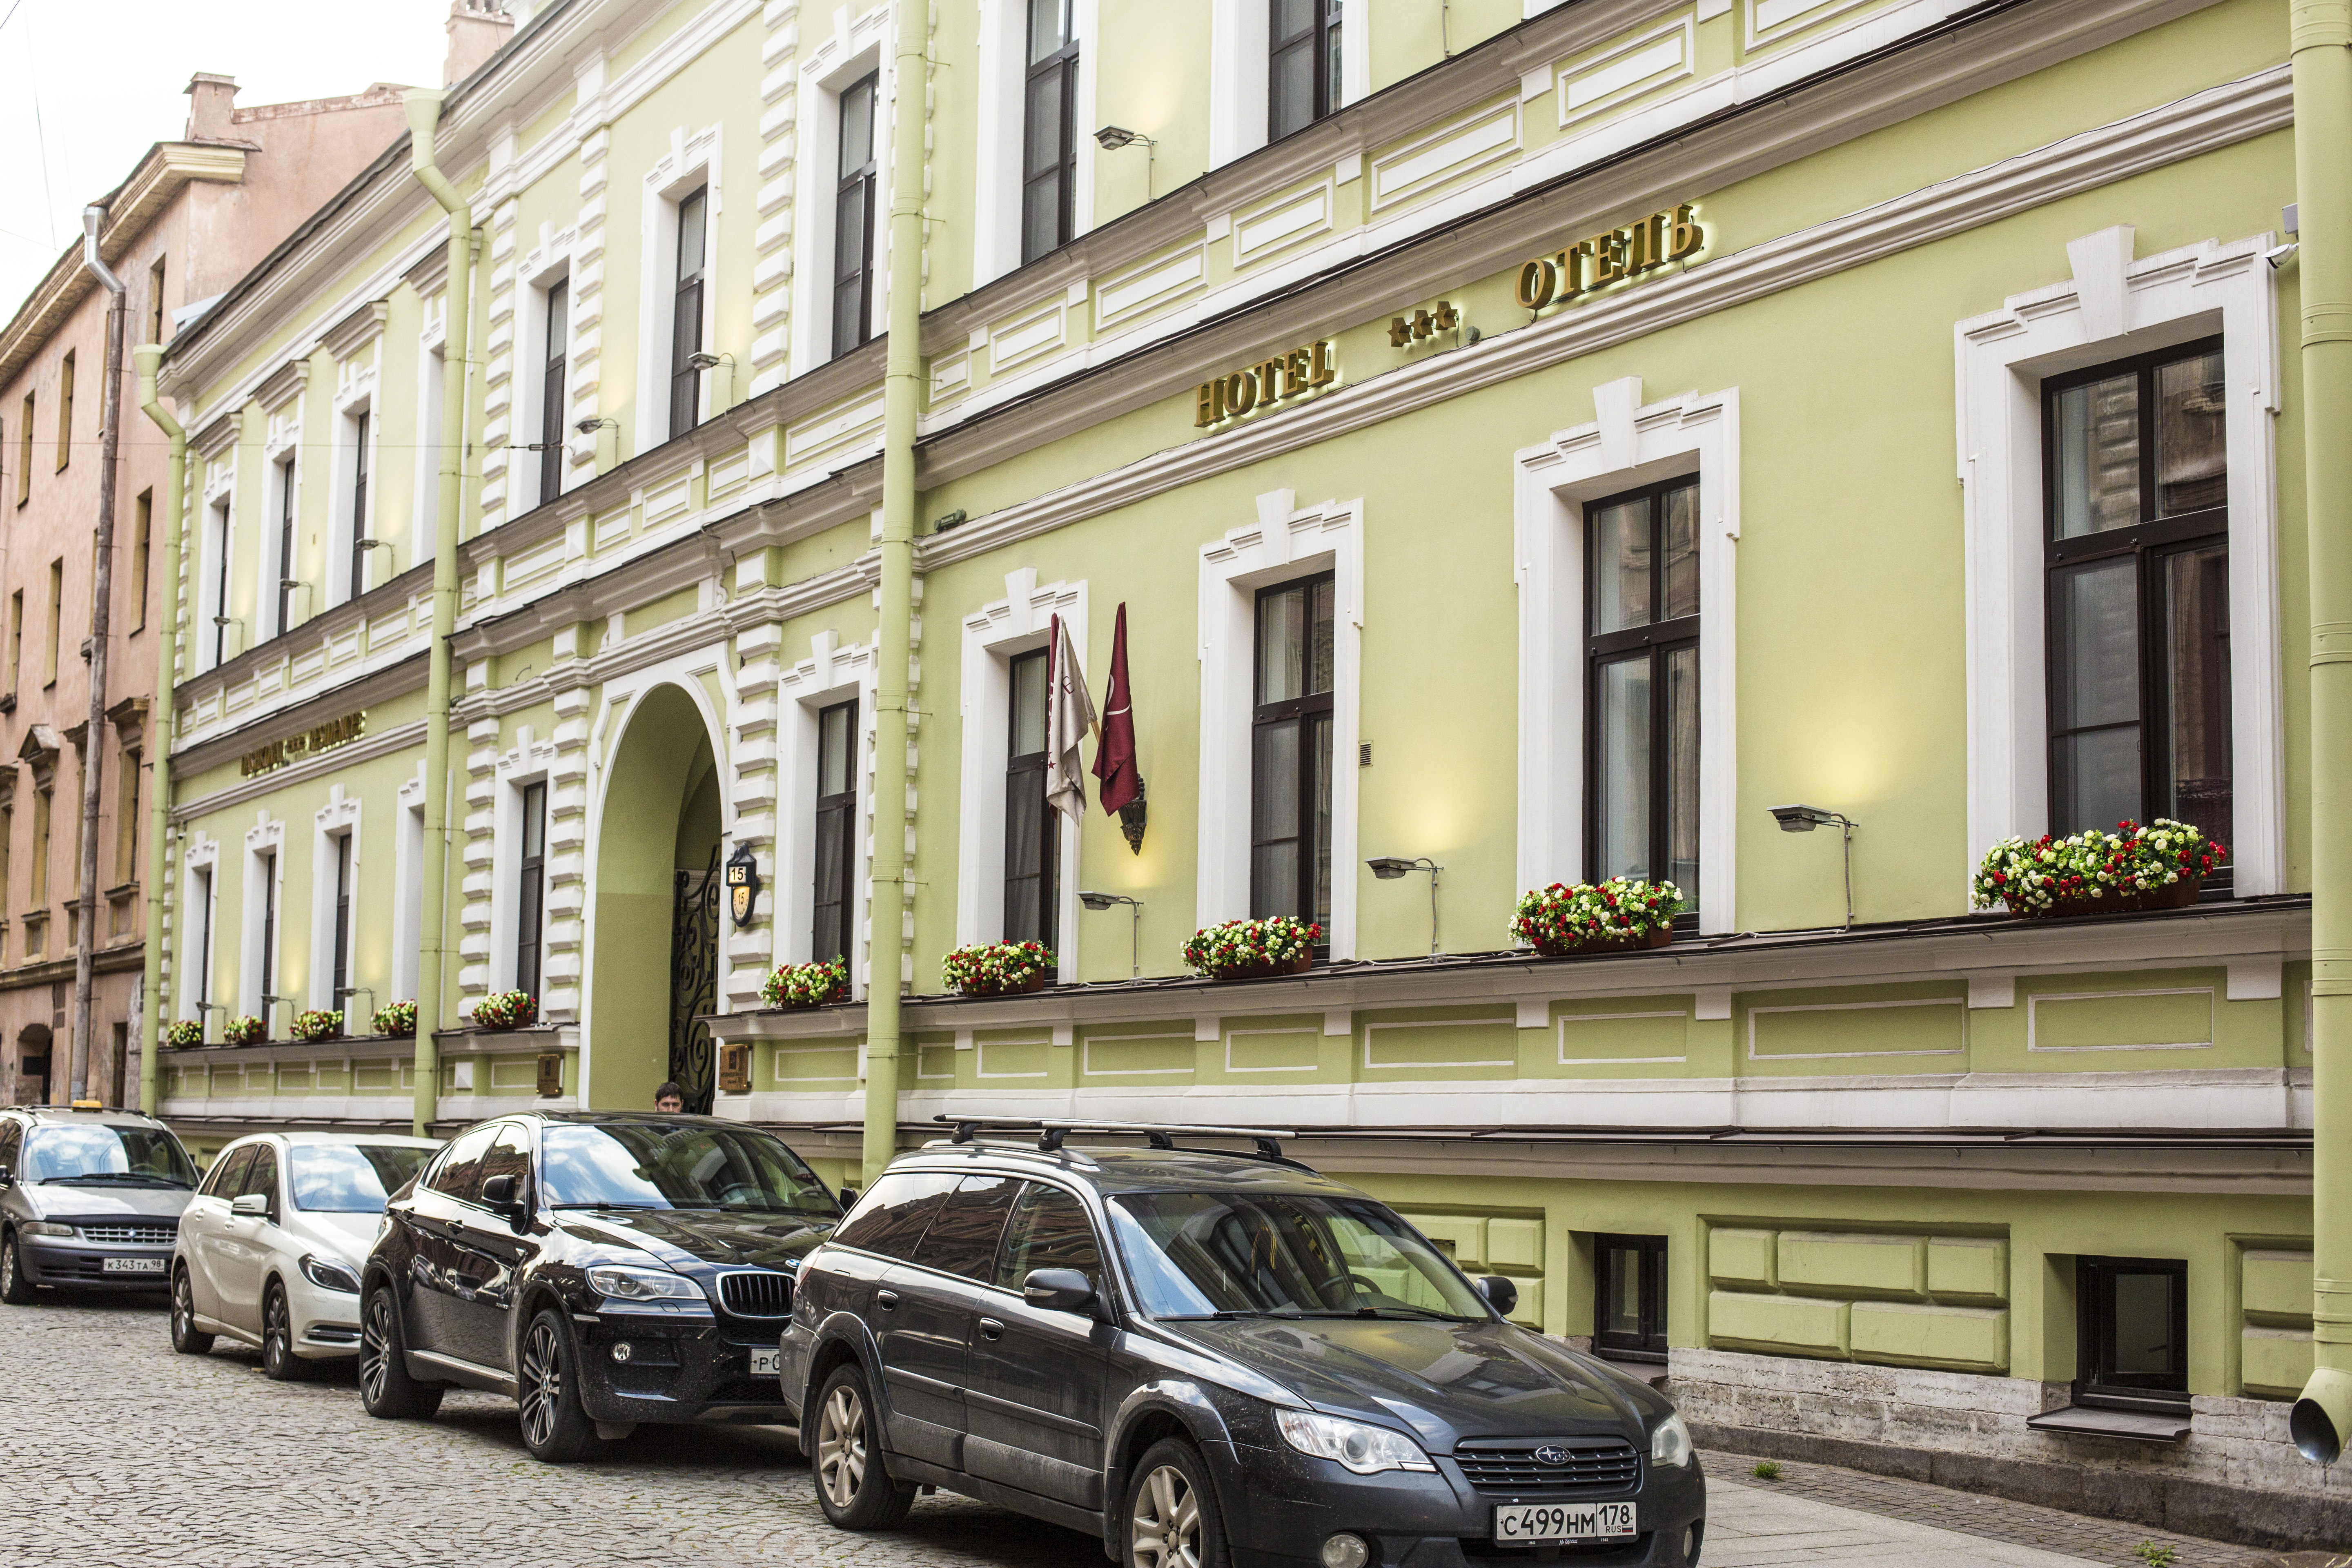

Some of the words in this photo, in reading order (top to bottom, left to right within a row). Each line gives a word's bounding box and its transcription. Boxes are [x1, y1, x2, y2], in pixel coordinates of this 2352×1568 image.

[1515, 204, 1704, 310] ОТЕЛЬ
[1194, 341, 1334, 428] HOTEL
[731, 868, 743, 880] 15
[738, 892, 744, 905] 15
[1599, 1505, 1630, 1525] 178
